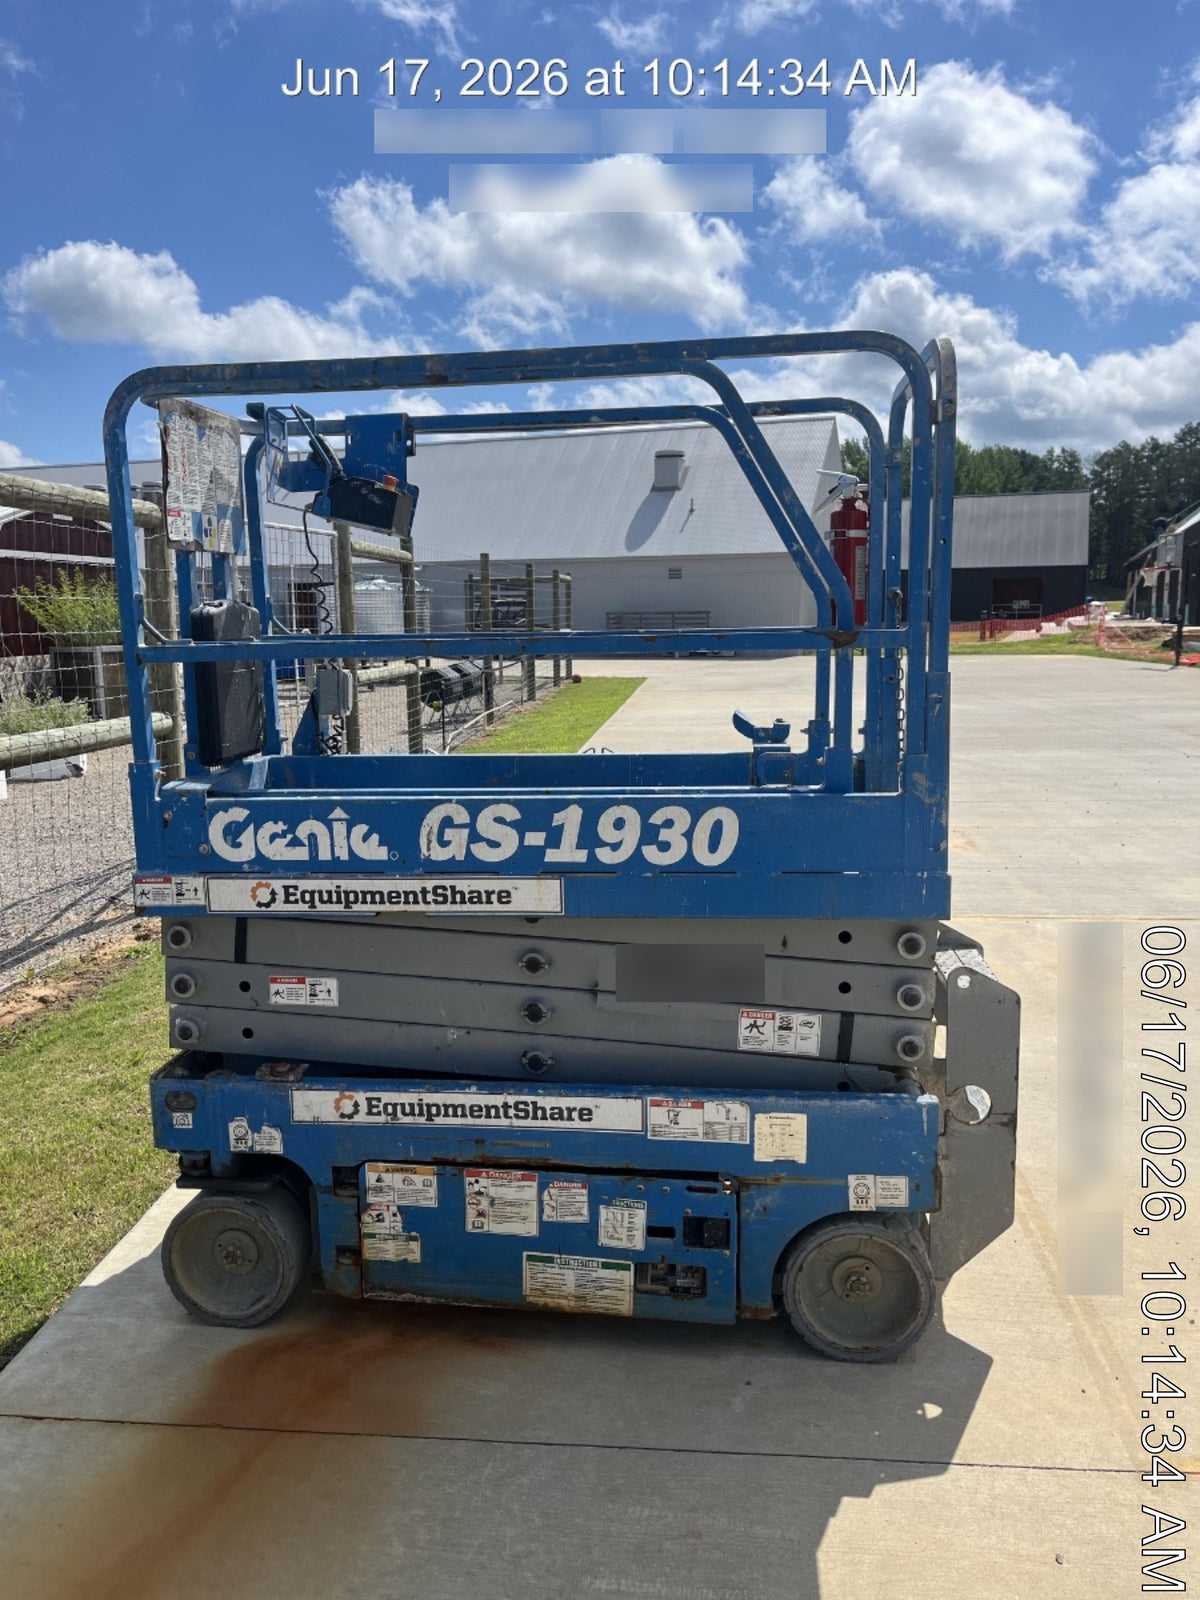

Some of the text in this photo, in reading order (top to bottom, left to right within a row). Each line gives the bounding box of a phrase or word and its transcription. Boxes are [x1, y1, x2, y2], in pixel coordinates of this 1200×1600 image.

[208, 803, 740, 866] Genie GS-1930
[282, 885, 512, 909] EquipmentShare
[365, 1097, 593, 1122] EquipmentShare
[489, 1171, 522, 1180] DANGER
